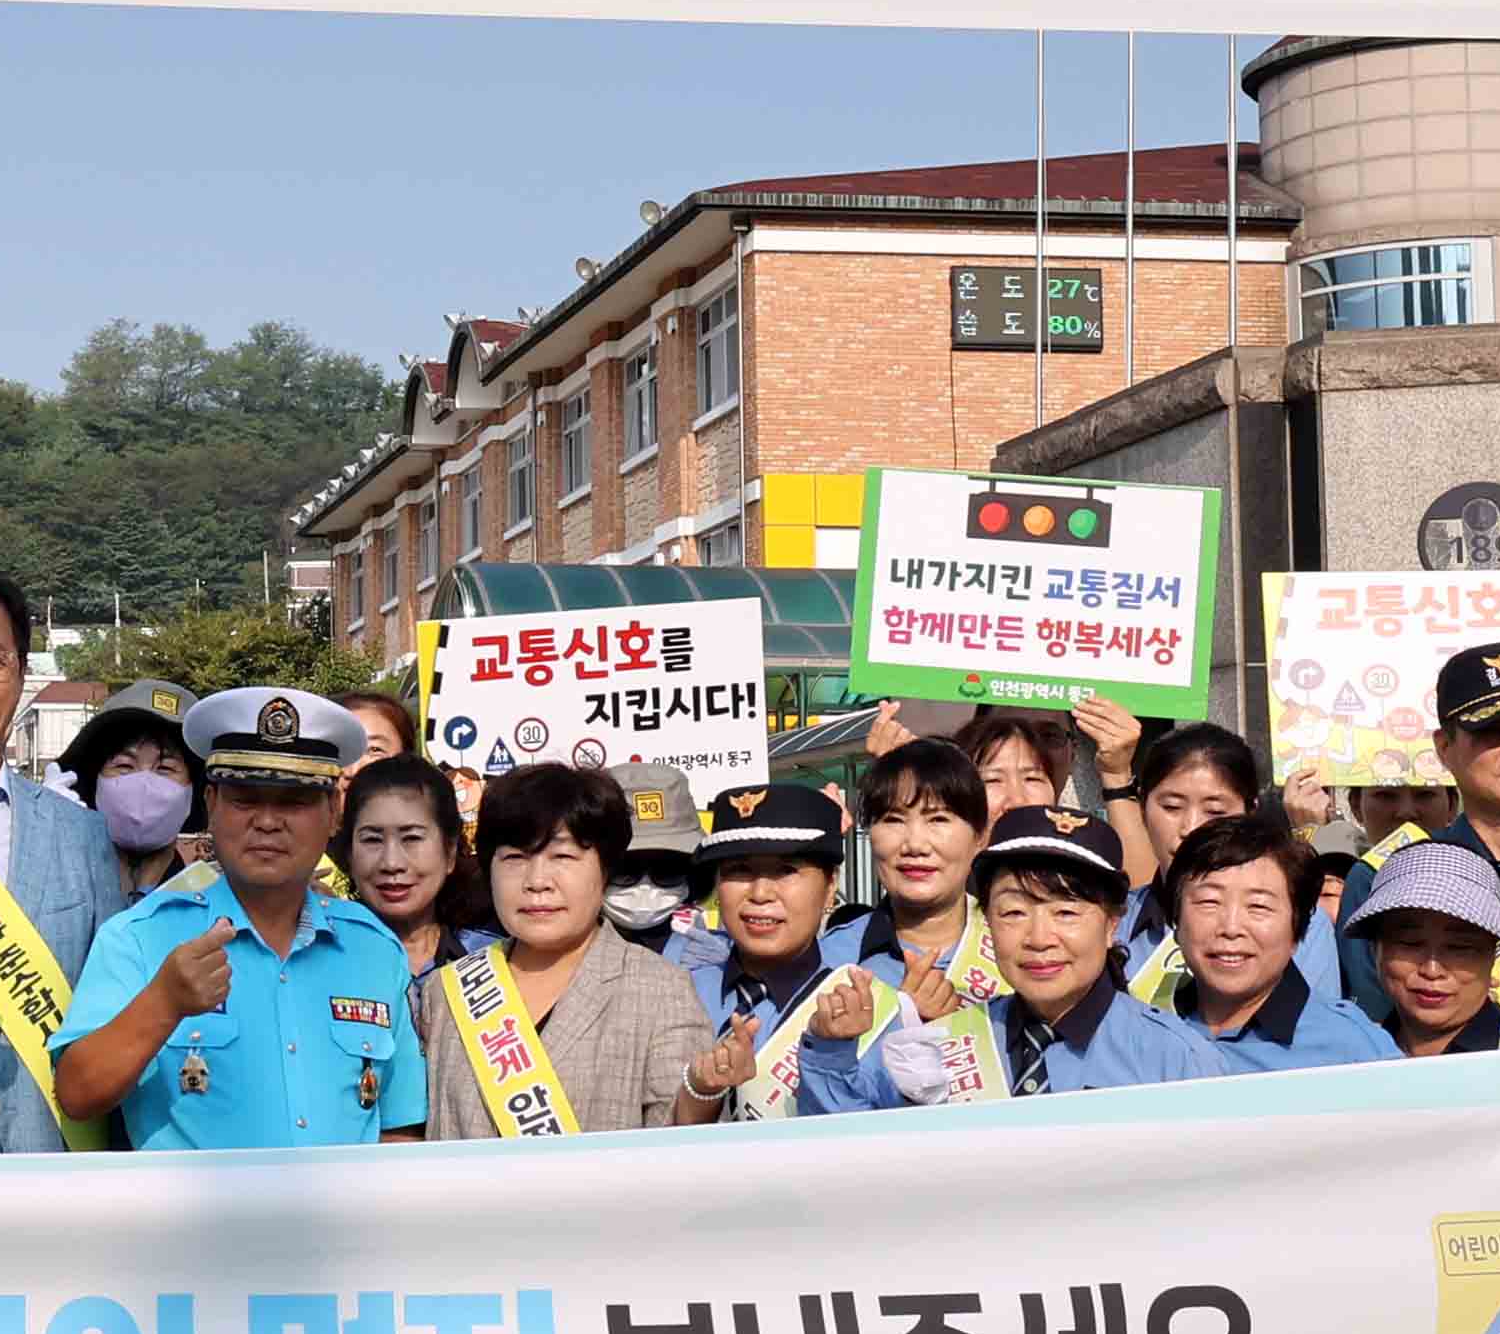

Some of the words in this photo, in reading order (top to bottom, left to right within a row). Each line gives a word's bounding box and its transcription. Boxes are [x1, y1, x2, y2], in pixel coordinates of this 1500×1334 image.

[890, 556, 1033, 595] 내가지킨
[1042, 567, 1182, 609] 교통질서
[468, 619, 696, 687] 교통신호를
[882, 603, 1026, 651] 함께만든
[1036, 616, 1183, 666] 행복세상
[583, 681, 760, 732] 지킵시다!
[989, 678, 1065, 702] 인천광역시
[725, 749, 753, 768] 동구
[479, 1018, 533, 1084] 낮게
